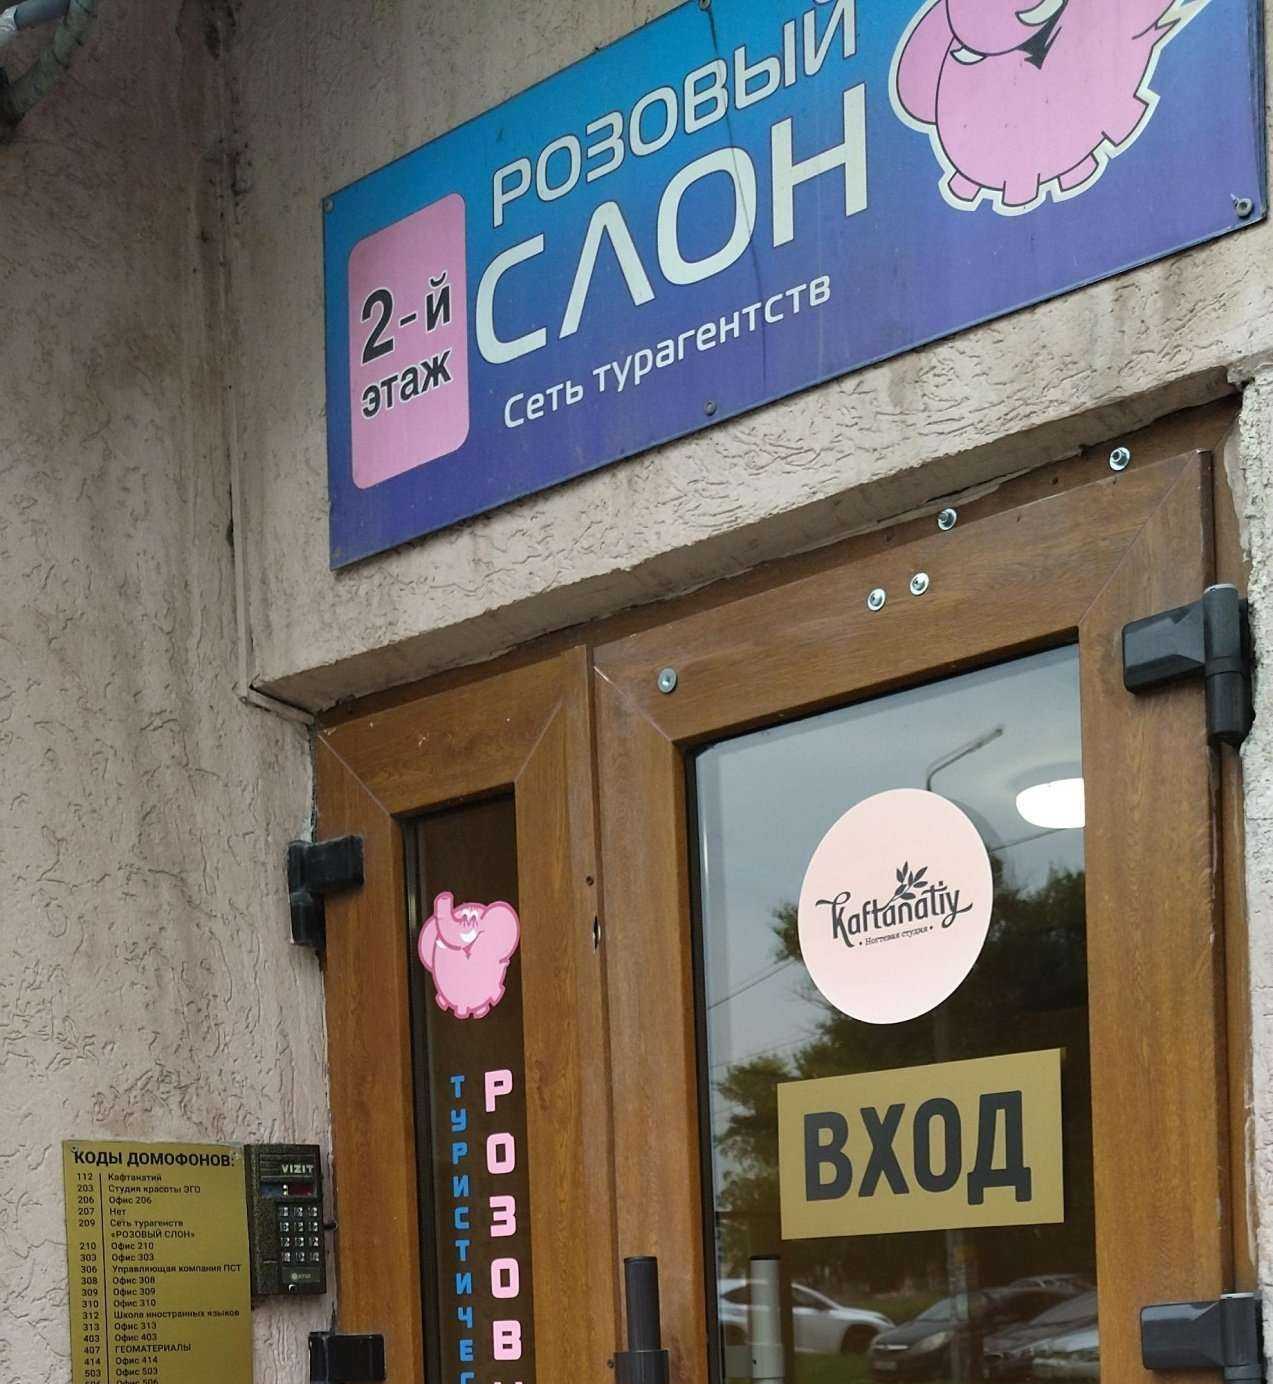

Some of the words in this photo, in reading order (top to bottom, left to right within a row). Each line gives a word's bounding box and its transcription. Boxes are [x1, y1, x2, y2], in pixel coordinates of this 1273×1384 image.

[493, 0, 857, 228] РОЗОВЫЙ
[475, 82, 867, 365] СЛОН
[361, 272, 451, 364] 2-й
[504, 381, 583, 428] Сеть
[593, 274, 831, 397] турагентств
[362, 350, 452, 417] этаж
[816, 881, 973, 948] Kaftanatiy
[901, 926, 928, 938] студия
[803, 1090, 1032, 1206] ВХОД
[74, 1151, 123, 1166] КОДЫ
[127, 1152, 235, 1168] ДОМОФОНОВ:
[281, 1164, 314, 1174] VIZIT
[77, 1173, 93, 1181] 112
[77, 1185, 94, 1193] 203
[108, 1185, 141, 1194] Студия
[143, 1186, 182, 1194] красоты
[78, 1196, 94, 1204] 206
[109, 1196, 134, 1205] Офис
[136, 1196, 152, 1204] 206
[78, 1208, 94, 1216] 207
[109, 1208, 126, 1216] Нет
[79, 1219, 95, 1227] 209
[110, 1219, 131, 1227] Сеть
[111, 1229, 162, 1239] «РОЗОВЫЙ
[80, 1242, 97, 1250] 210
[111, 1242, 135, 1251] Офис
[138, 1242, 154, 1250] 210
[80, 1254, 97, 1262] 303
[112, 1254, 136, 1263] Офис
[81, 1265, 97, 1273] 306
[112, 1265, 176, 1275] Управляющая
[178, 1265, 221, 1273] компания
[223, 1264, 241, 1272] ПСТ
[81, 1277, 98, 1285] 308
[113, 1277, 137, 1286] Офис
[82, 1289, 98, 1297] 309
[113, 1288, 137, 1297] Офис
[139, 1288, 156, 1296] 309
[82, 1300, 99, 1308] 310
[114, 1300, 138, 1309] Офис
[83, 1312, 99, 1320] 312
[114, 1311, 144, 1319] Школа
[146, 1310, 205, 1319] иностранных
[83, 1323, 100, 1331] 313
[114, 1322, 138, 1332] Офис
[140, 1322, 157, 1330] 313
[115, 1334, 139, 1343] Офис
[141, 1333, 157, 1341] 403
[84, 1346, 100, 1354] 407
[115, 1344, 191, 1353] ГЕОМАТЕРИАЛЫ
[84, 1358, 101, 1366] 414
[116, 1357, 139, 1366] Офис
[142, 1356, 158, 1364] 414
[116, 1368, 140, 1377] Офис
[142, 1367, 158, 1375] 503
